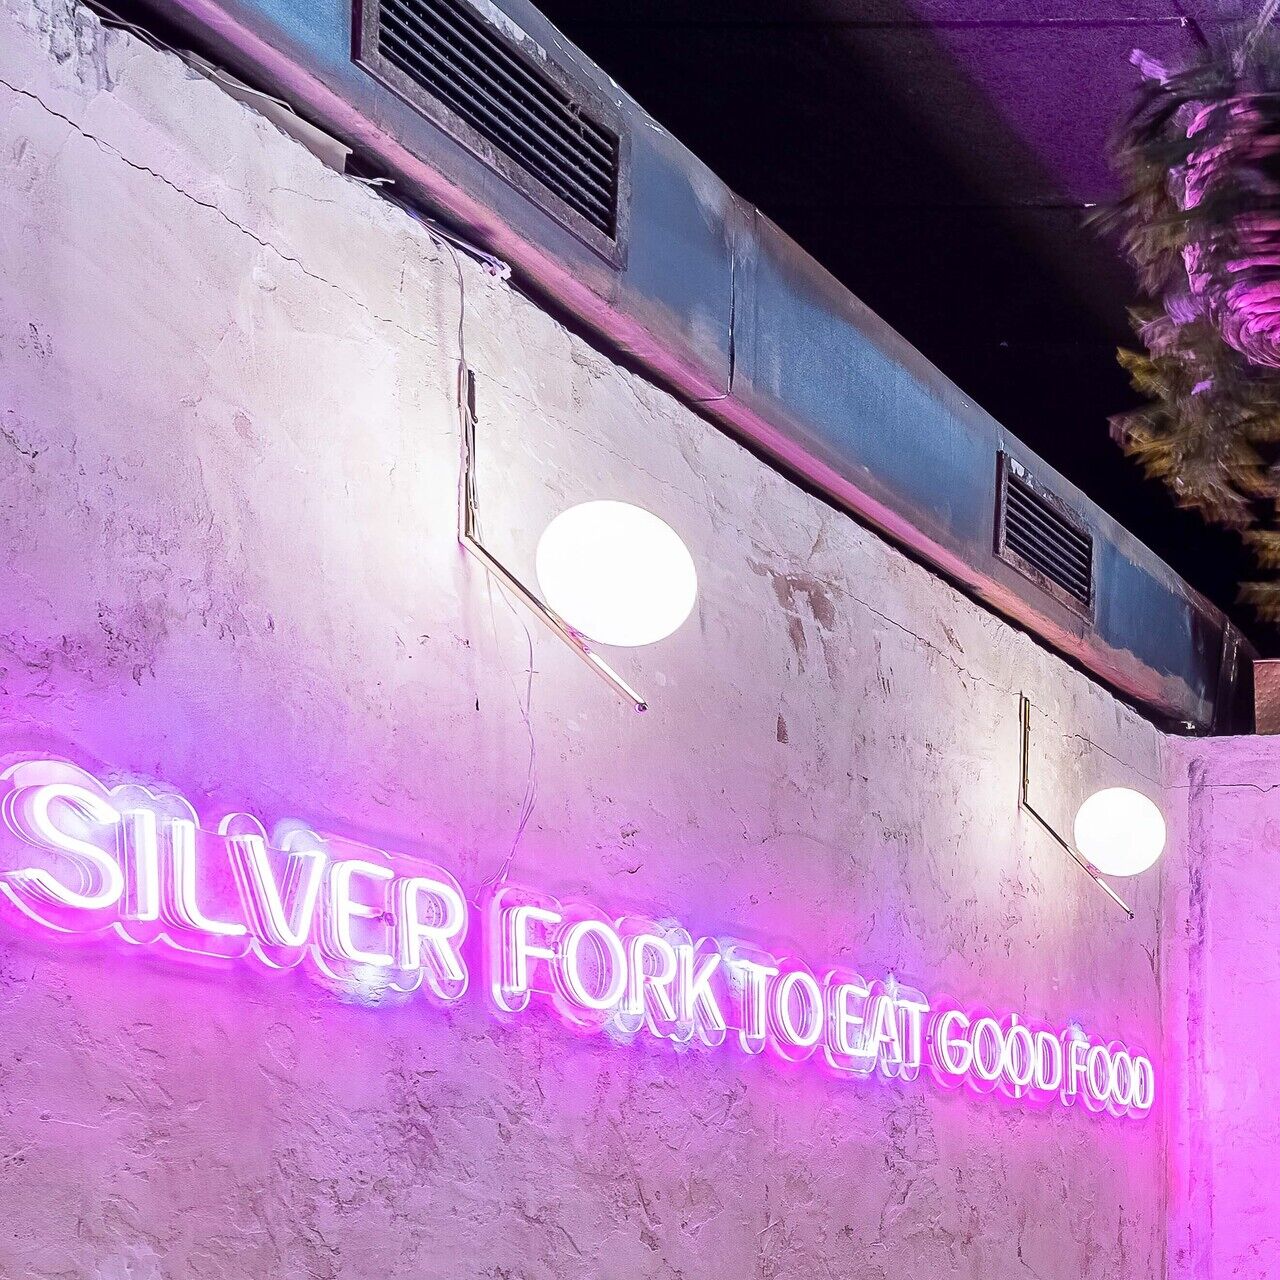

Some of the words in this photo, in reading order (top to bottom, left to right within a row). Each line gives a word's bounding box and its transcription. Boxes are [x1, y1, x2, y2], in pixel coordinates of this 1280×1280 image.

[10, 782, 466, 985] SILVER
[500, 905, 727, 1031] FORK
[729, 958, 824, 1048] TO
[825, 983, 930, 1068] EAT
[931, 1010, 1062, 1098] GOOD
[1062, 1040, 1154, 1110] FOOD
